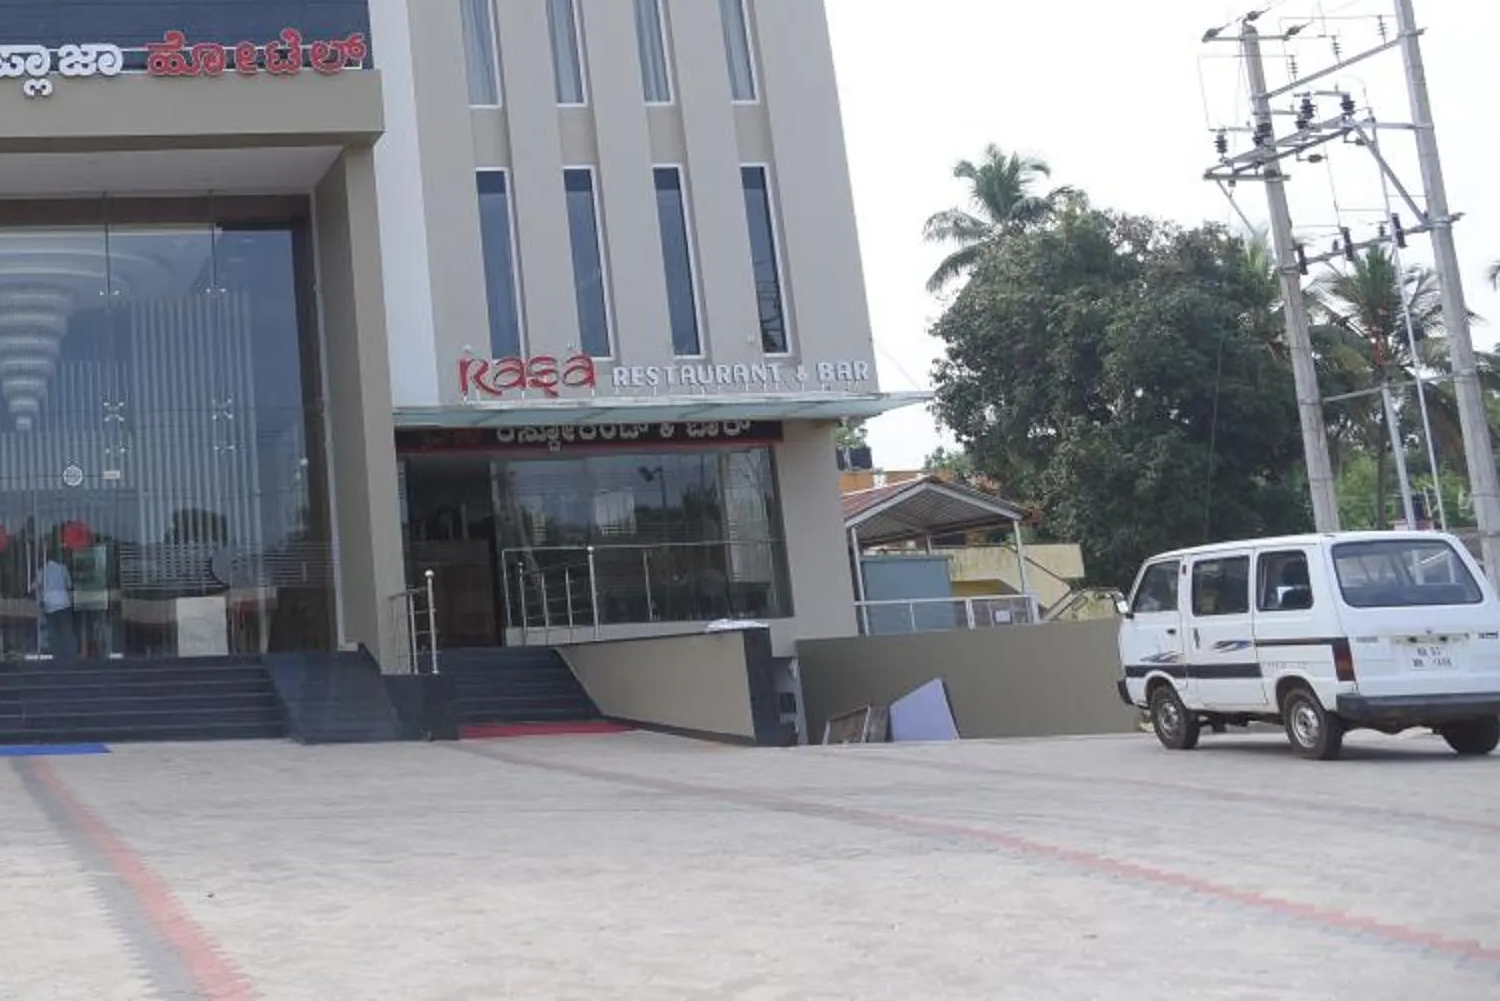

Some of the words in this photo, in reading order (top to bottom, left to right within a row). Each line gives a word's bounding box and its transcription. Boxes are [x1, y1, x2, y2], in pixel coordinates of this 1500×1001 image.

[145, 27, 367, 76] ಹೋಟೆಲ್
[612, 362, 782, 386] RESTAURANT
[815, 360, 869, 382] BAR
